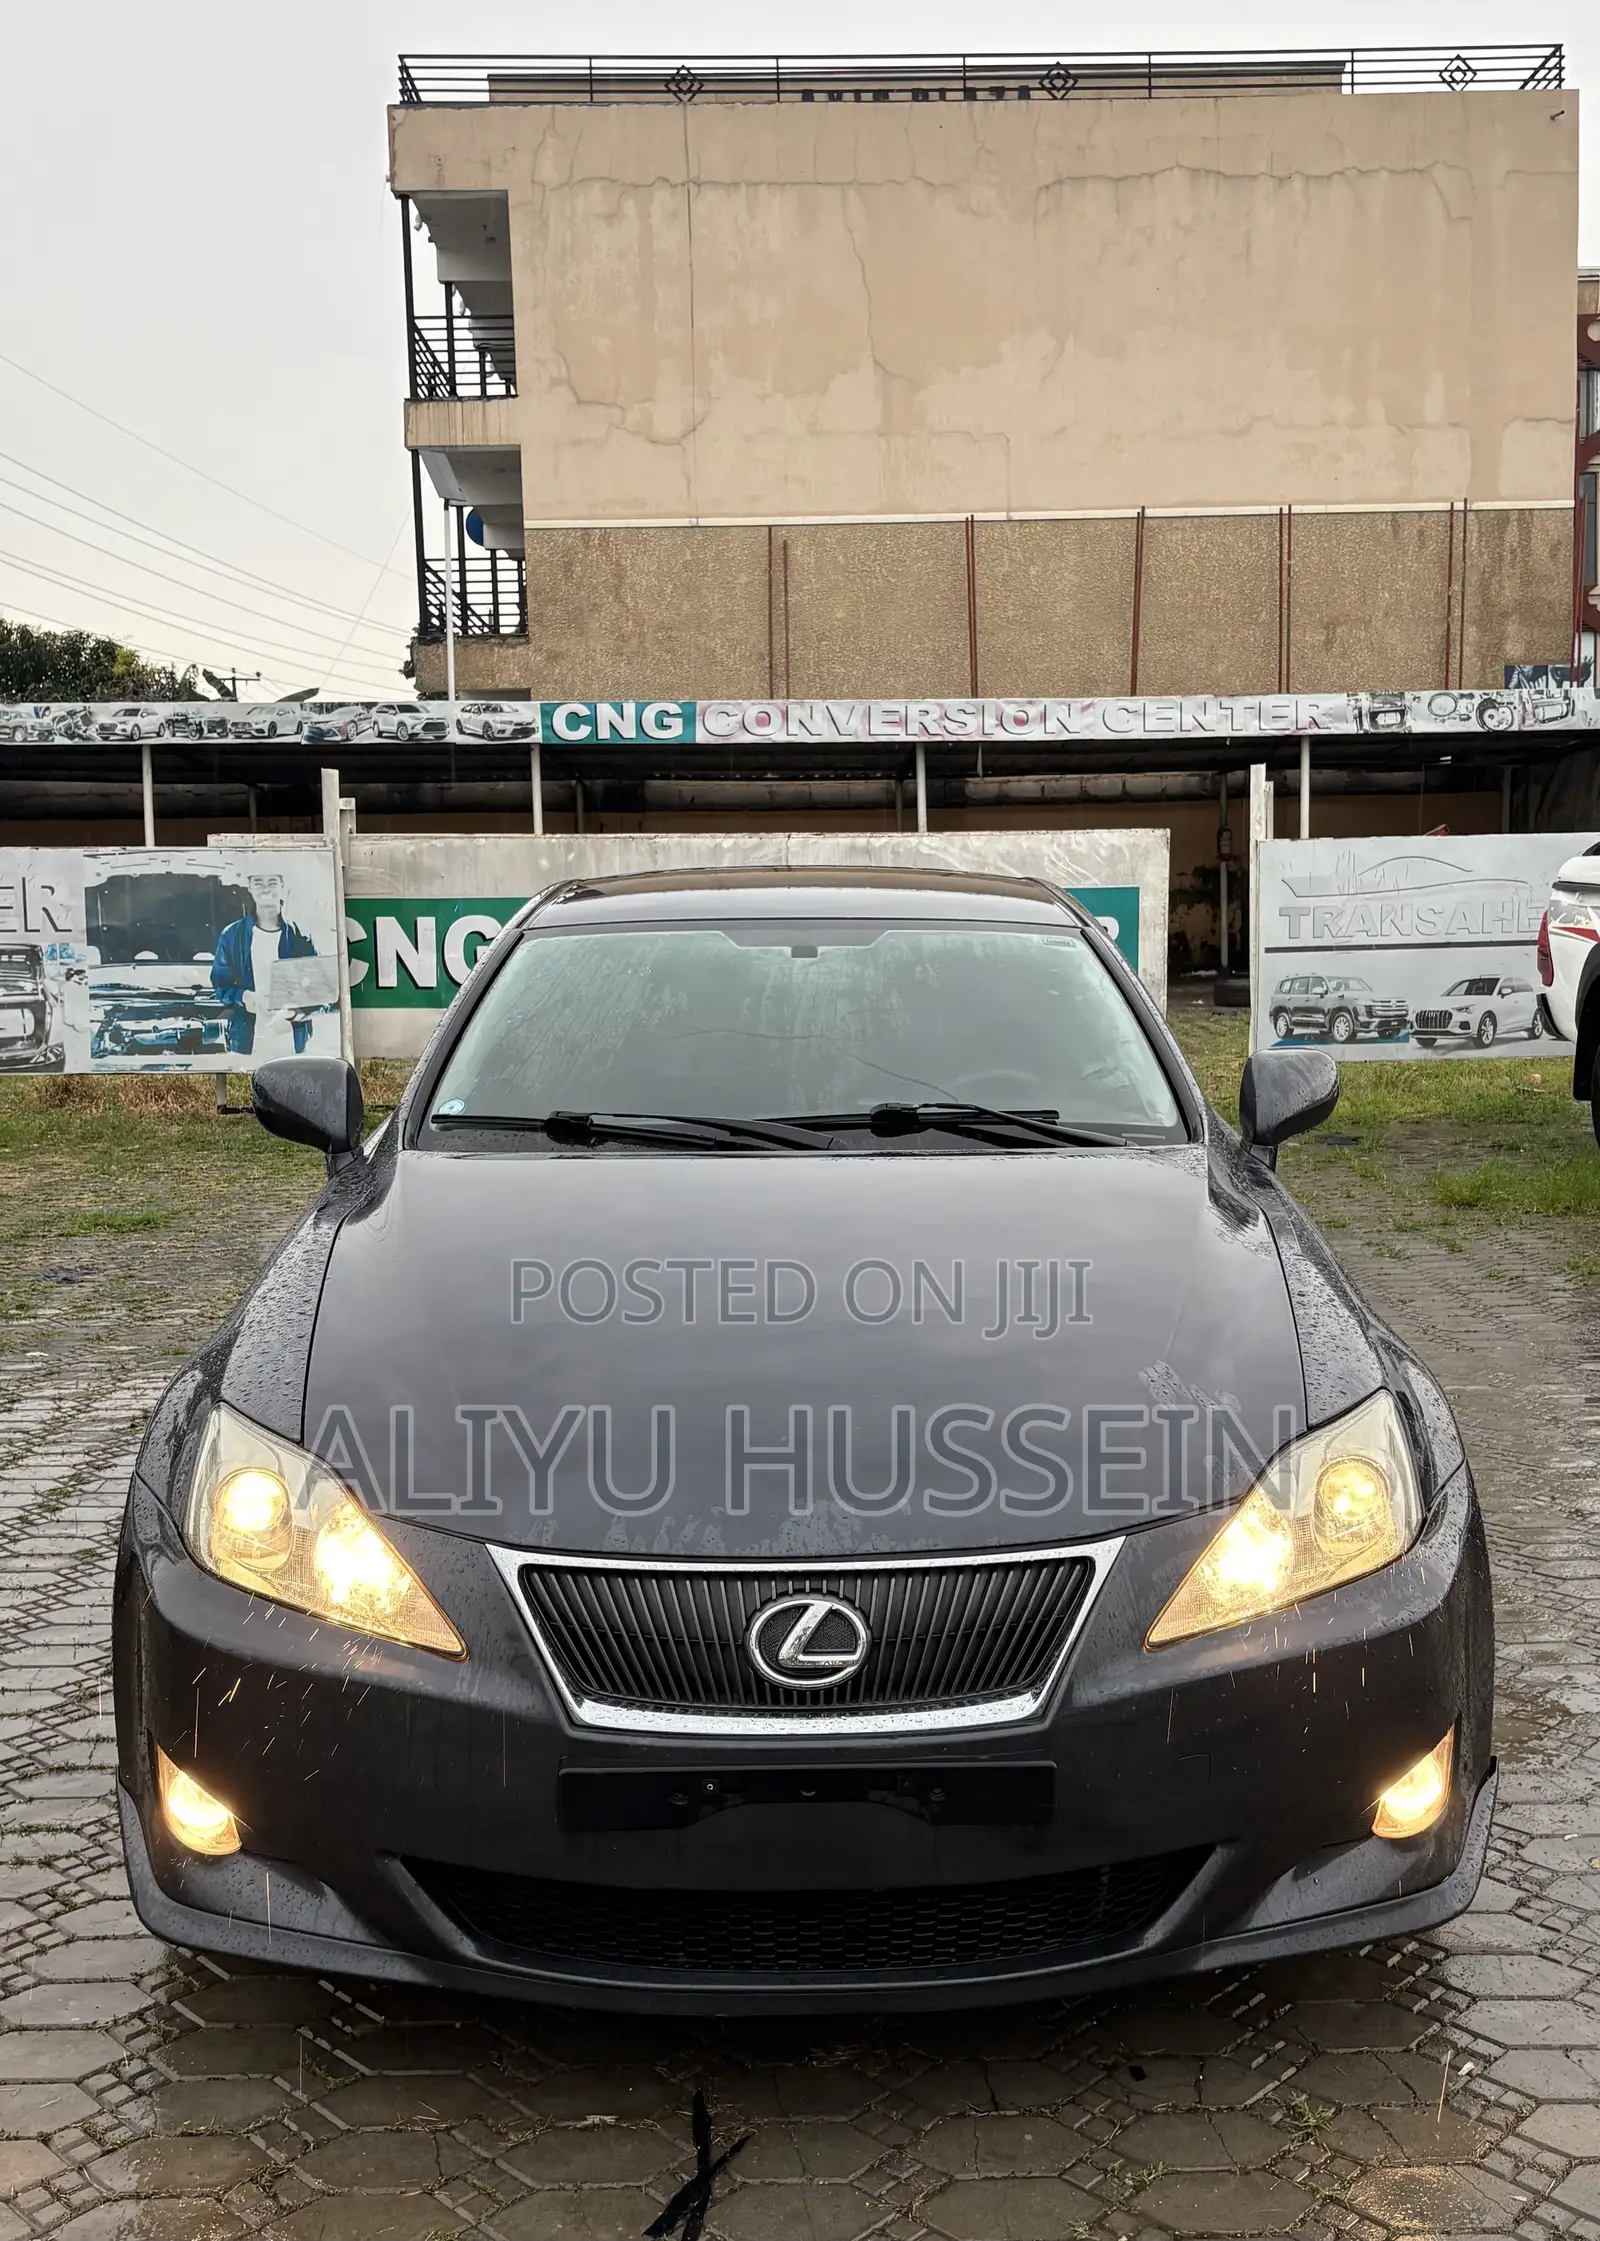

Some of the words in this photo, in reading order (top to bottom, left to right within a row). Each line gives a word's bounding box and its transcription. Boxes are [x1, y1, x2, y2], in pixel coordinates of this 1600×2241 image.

[552, 702, 684, 741] CNG
[703, 700, 1080, 738] CONVERSION
[1101, 698, 1332, 735] CENTER
